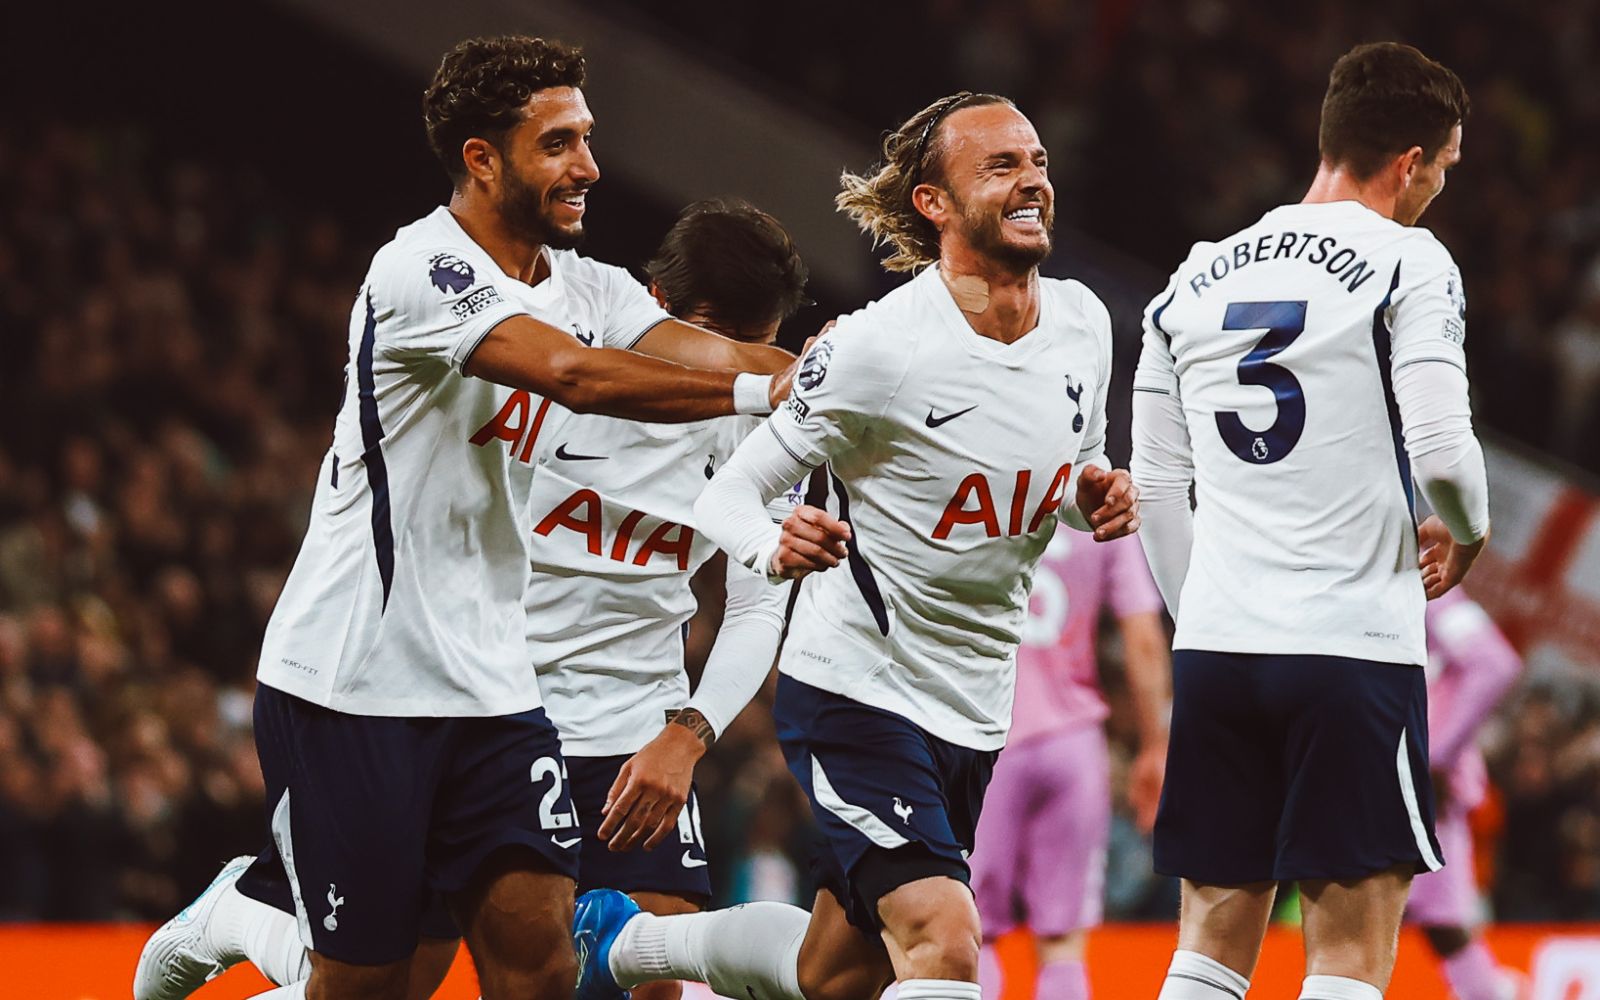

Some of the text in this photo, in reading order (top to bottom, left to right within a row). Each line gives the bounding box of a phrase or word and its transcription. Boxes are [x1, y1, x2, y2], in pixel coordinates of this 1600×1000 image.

[451, 286, 498, 317] No room
[1189, 231, 1375, 298] ROBERTSON
[1214, 300, 1308, 465] 3
[469, 388, 553, 464] AI
[532, 488, 695, 571] AIA
[931, 462, 1072, 540] AIA
